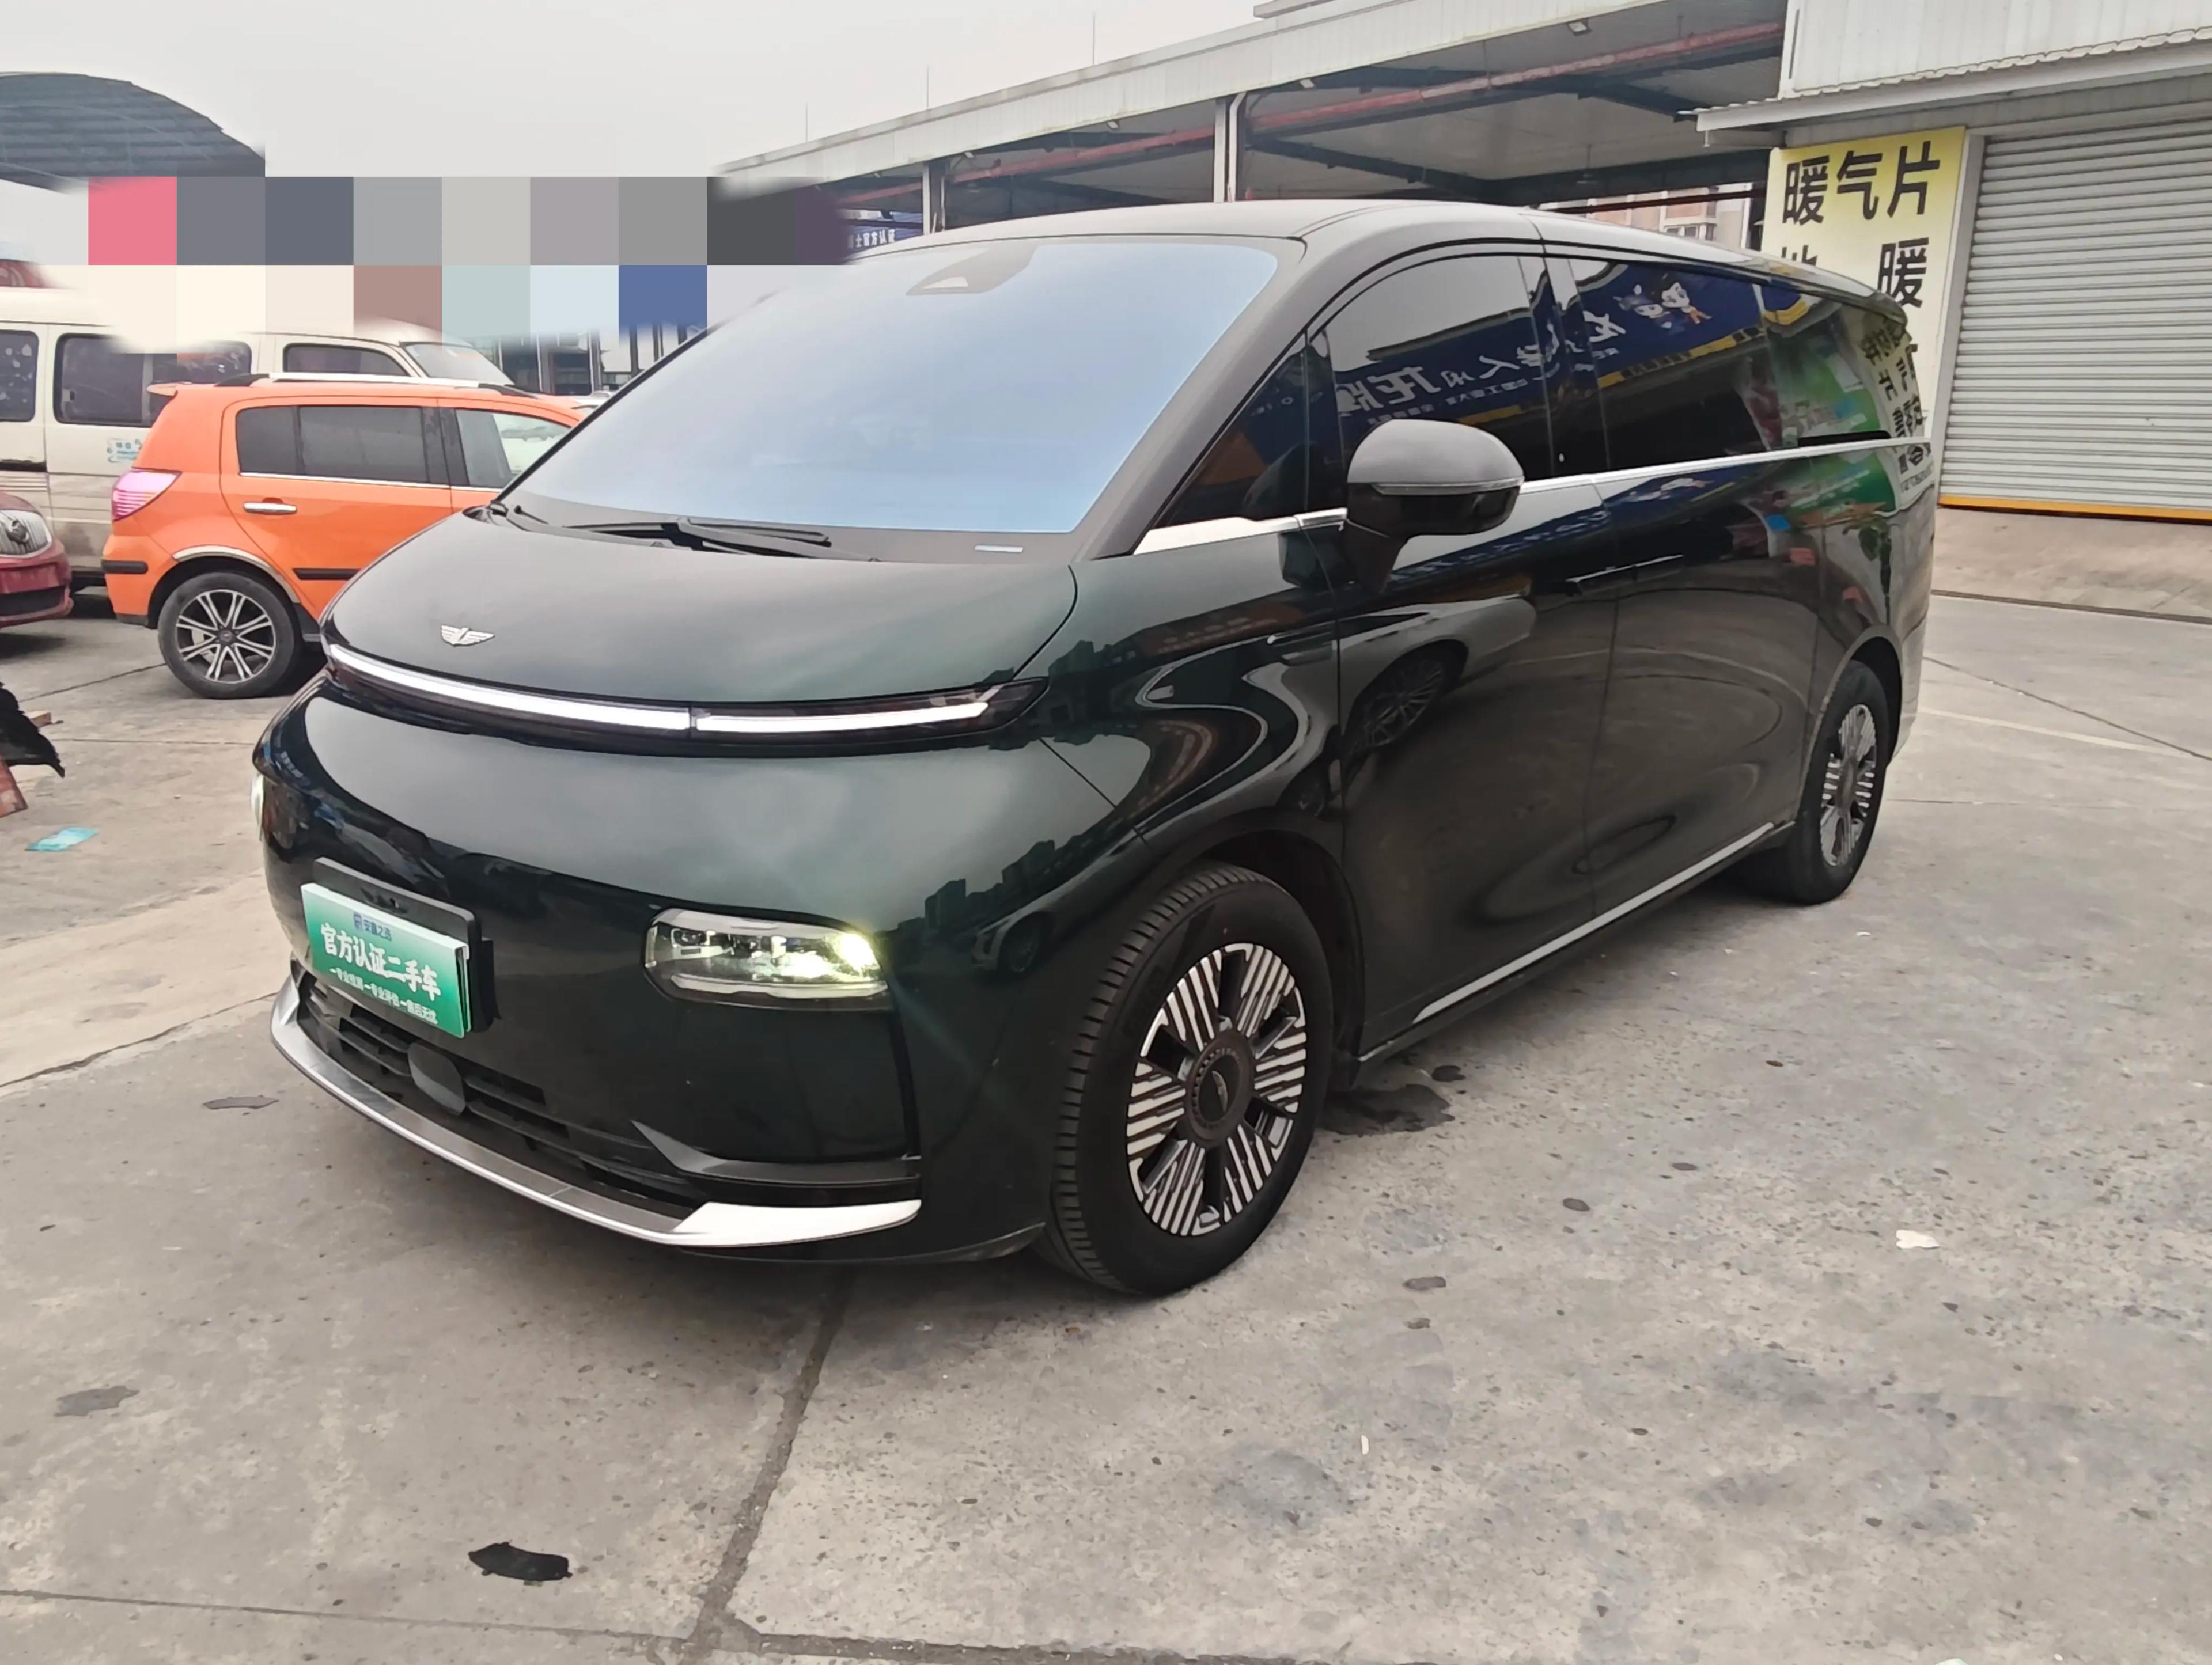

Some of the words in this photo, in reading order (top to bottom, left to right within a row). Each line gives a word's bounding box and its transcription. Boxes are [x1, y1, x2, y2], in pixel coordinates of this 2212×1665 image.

[1782, 140, 1941, 226] 暖气片
[1877, 237, 1929, 308] 暖
[321, 922, 441, 1001] 官方认证二手车
